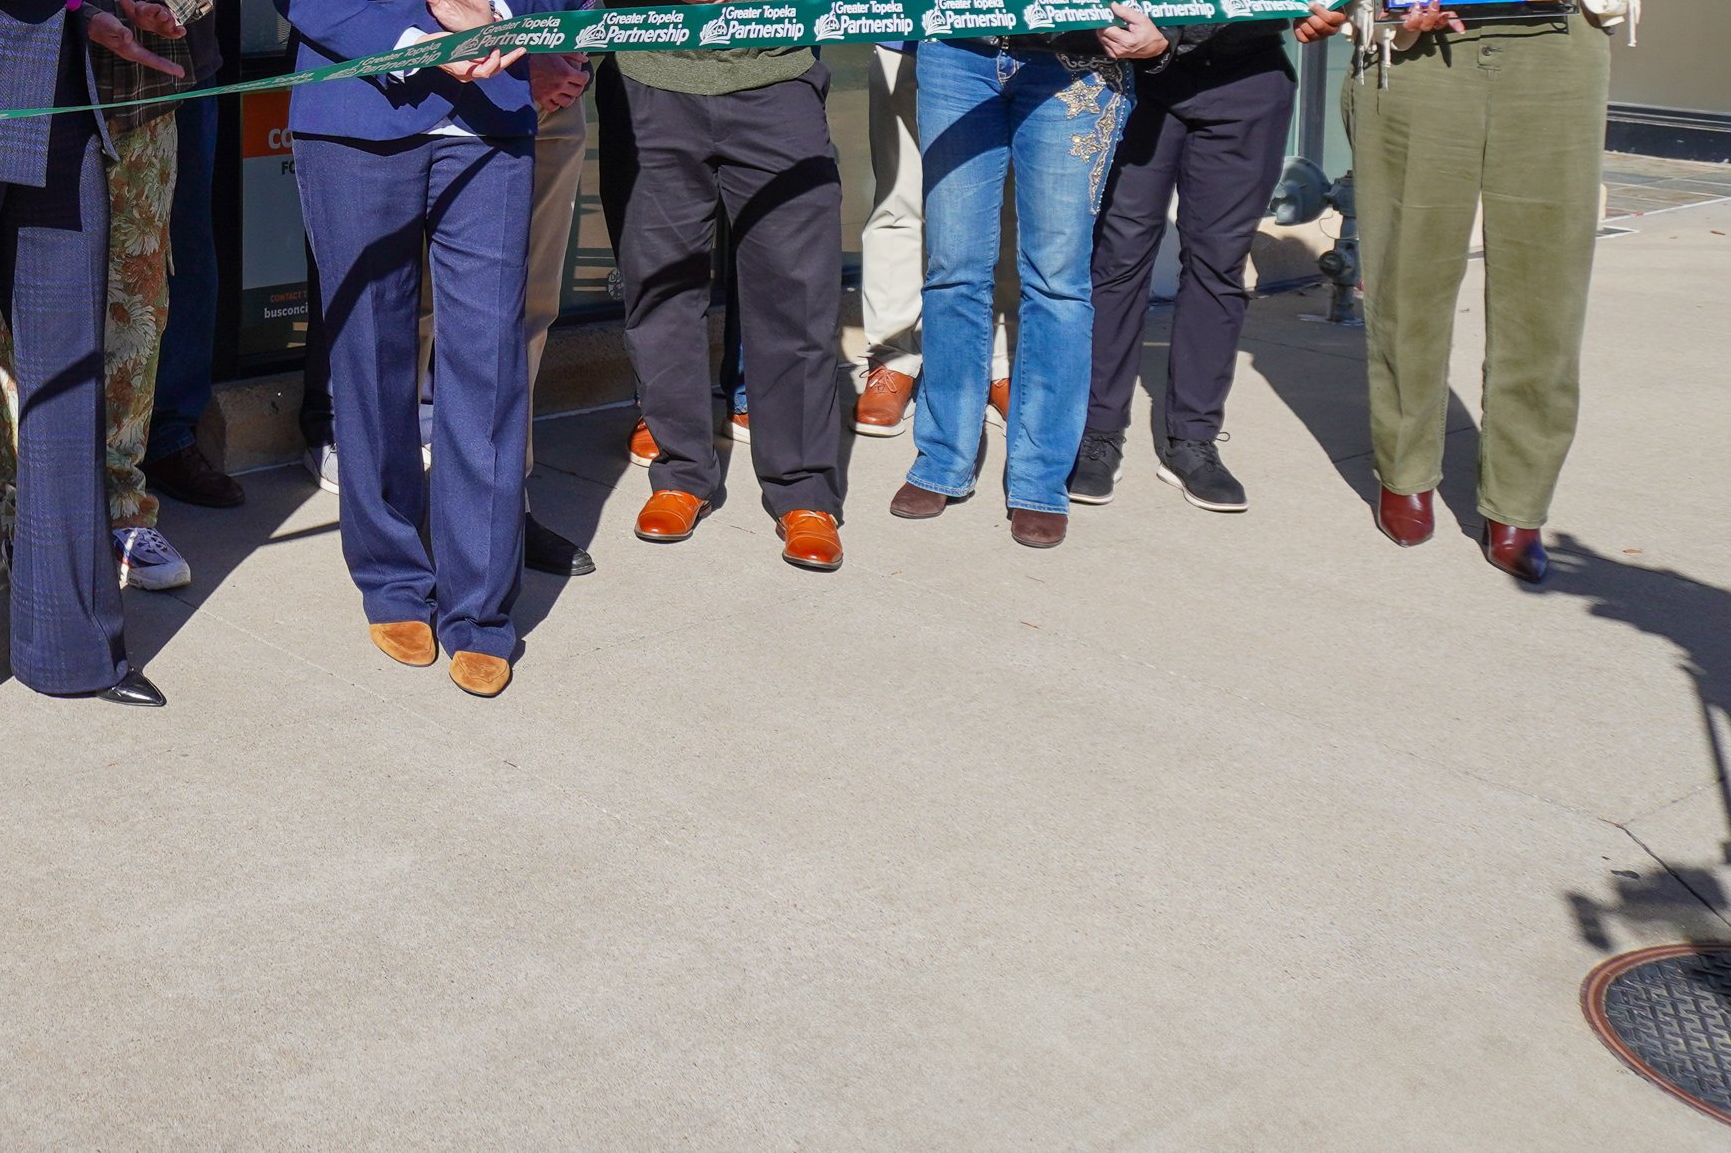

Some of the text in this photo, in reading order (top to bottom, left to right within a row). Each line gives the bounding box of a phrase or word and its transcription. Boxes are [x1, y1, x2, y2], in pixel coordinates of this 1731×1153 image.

[726, 5, 796, 20] Greater Topeka
[835, 0, 903, 15] Greater Topeka
[1046, 3, 1114, 23] Partnership
[482, 16, 561, 36] Greater Topeka
[607, 10, 684, 26] Greater Topeka
[840, 14, 914, 36] Partnership
[945, 9, 1017, 31] Partnership
[478, 28, 565, 49] Partnership
[606, 24, 690, 46] Partnership
[728, 19, 805, 42] Partnership
[264, 302, 309, 319] busconci
